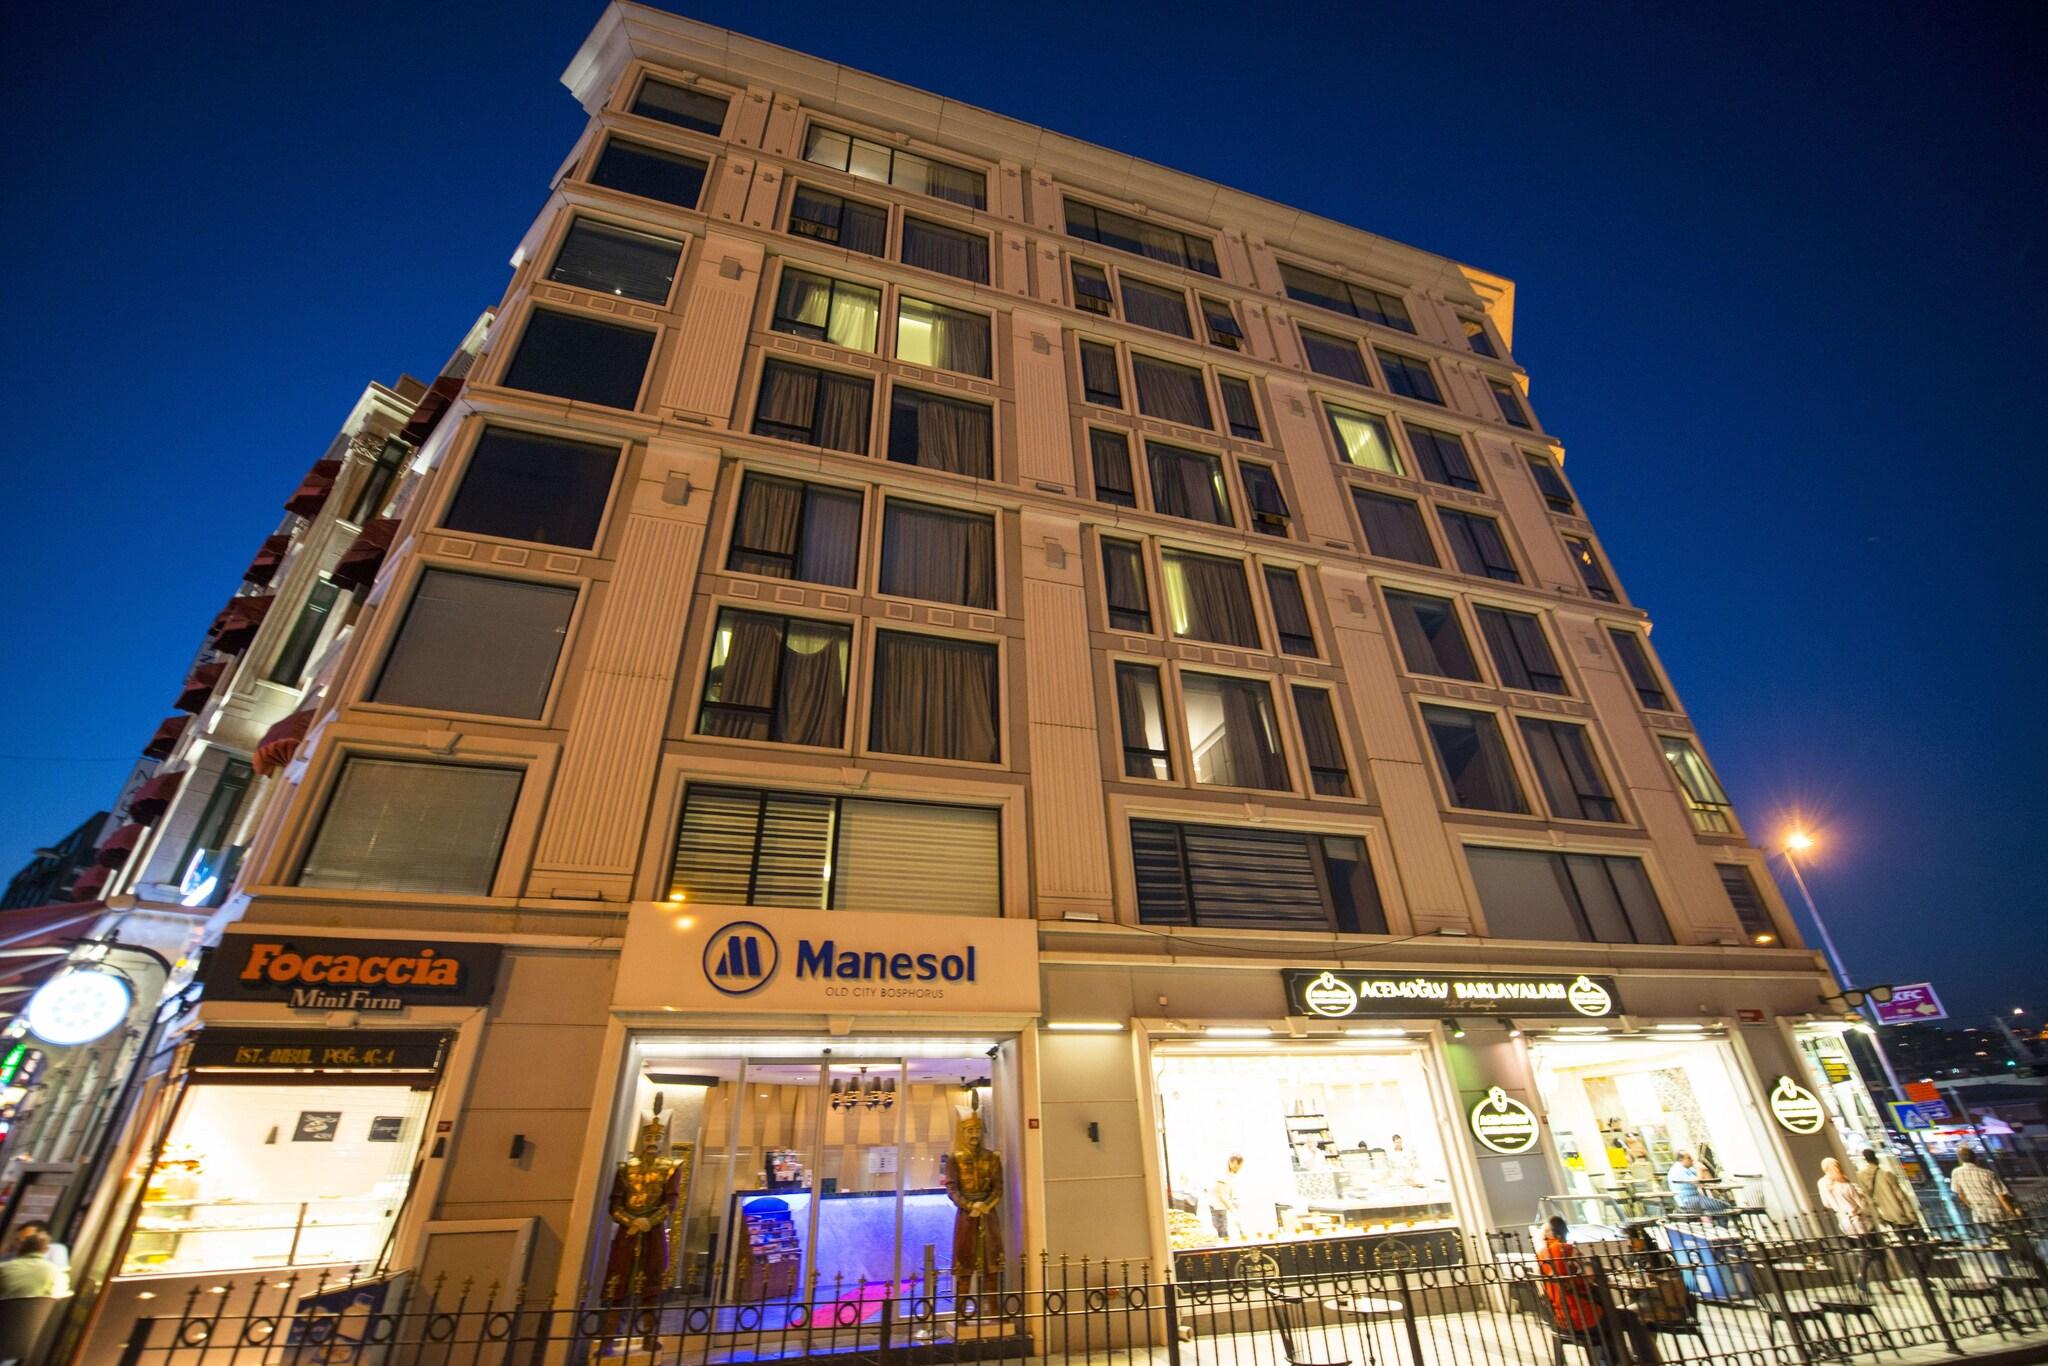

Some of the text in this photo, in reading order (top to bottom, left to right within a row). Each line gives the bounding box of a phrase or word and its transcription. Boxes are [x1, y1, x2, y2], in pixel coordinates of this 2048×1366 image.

[240, 943, 459, 985] Focaccia
[796, 939, 976, 982] Manesol
[289, 988, 346, 1008] Mini
[825, 986, 944, 999] OLD CITY BOSPHORUS
